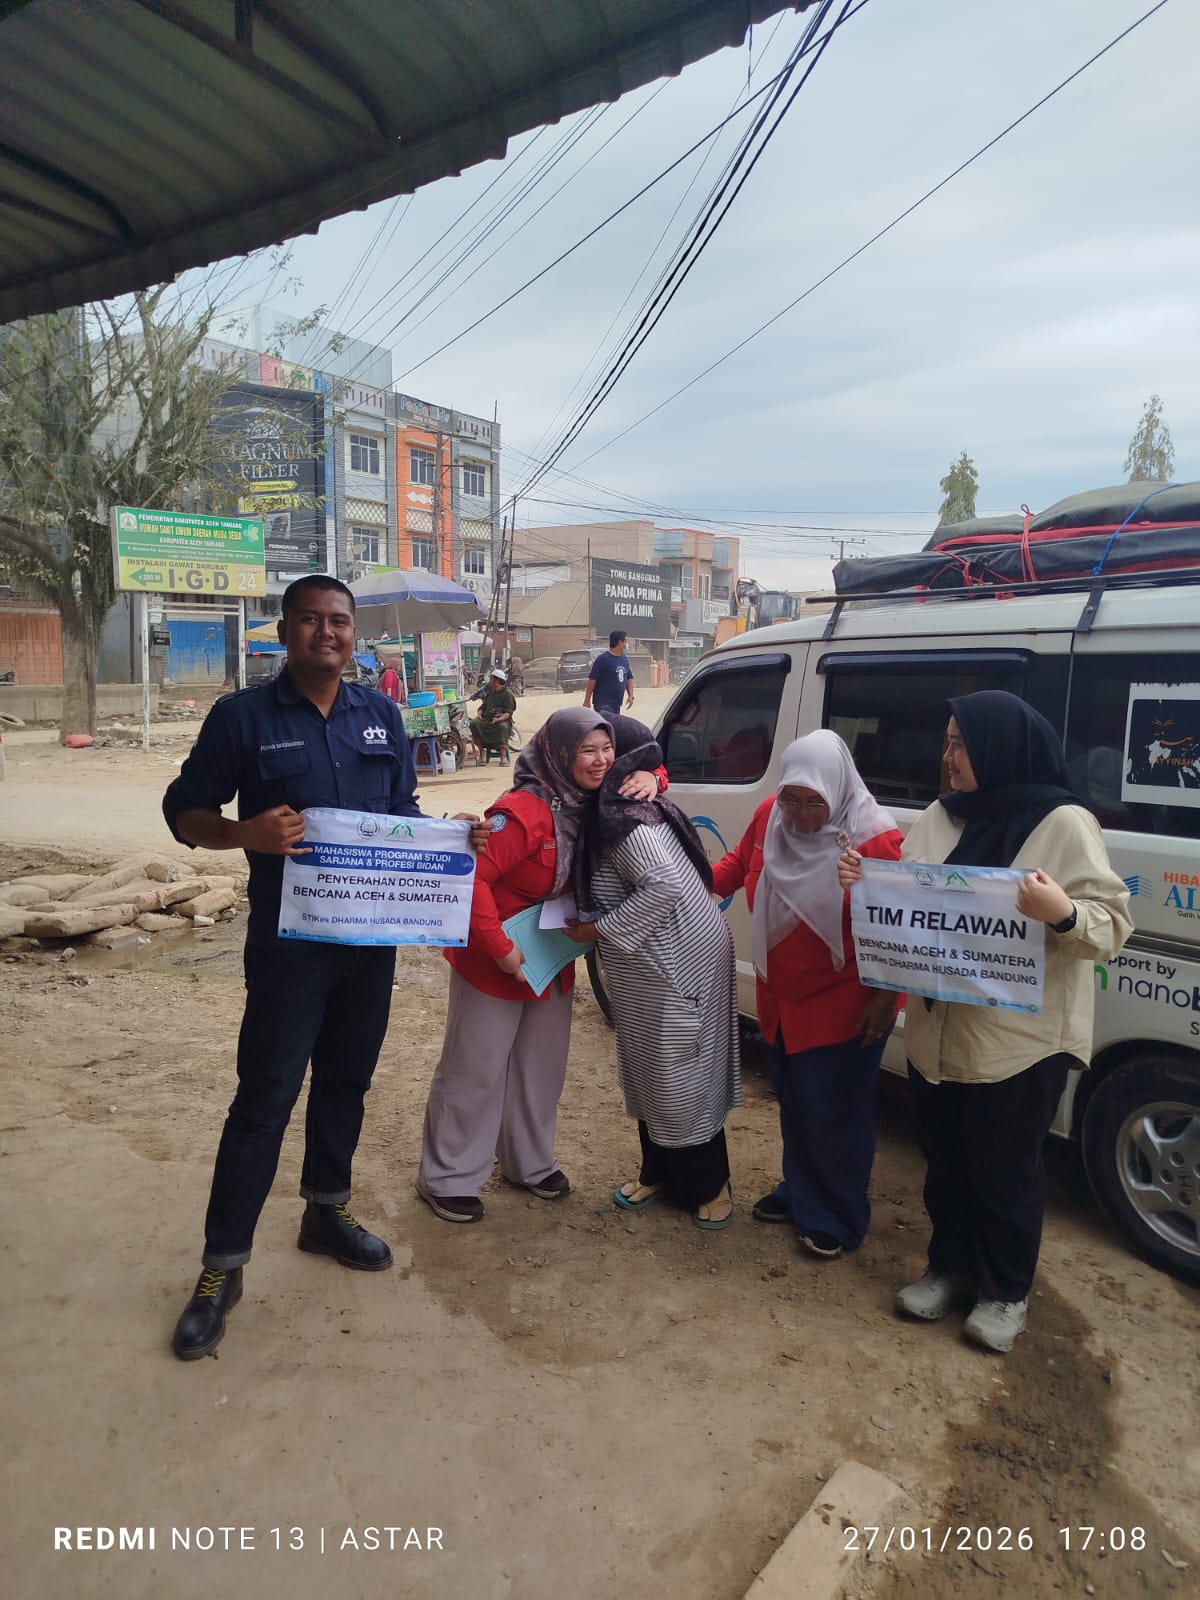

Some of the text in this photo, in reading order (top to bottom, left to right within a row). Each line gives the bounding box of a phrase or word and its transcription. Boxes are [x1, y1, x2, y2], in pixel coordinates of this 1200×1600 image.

[240, 464, 300, 478] FILTER
[174, 517, 204, 526] KABUPATEN
[128, 559, 166, 567] INSTALASI
[610, 569, 660, 583] TOKO BANGUNAN
[605, 584, 662, 602] PANDA PRIMA
[614, 602, 654, 618] KERAMIK
[314, 846, 451, 862] MAHASISWA PROGRAM STUDI
[319, 855, 364, 866] SARJANA
[375, 859, 414, 869] PROFESI
[416, 861, 444, 871] BIDAN
[317, 874, 441, 888] PENYERAHAN DONASI
[293, 886, 459, 904] BENCANA ACEH & SUMATERA
[302, 914, 329, 922] STIKes
[332, 916, 368, 925] DHARMA
[403, 919, 442, 927] BANDUNG
[866, 905, 1027, 940] TIM RELAWAN
[859, 937, 1036, 969] BENCANA ACEH & SUMATERA
[859, 953, 1037, 986] STIKes DHARMA HUSADA BANDUNG
[1157, 961, 1176, 979] by
